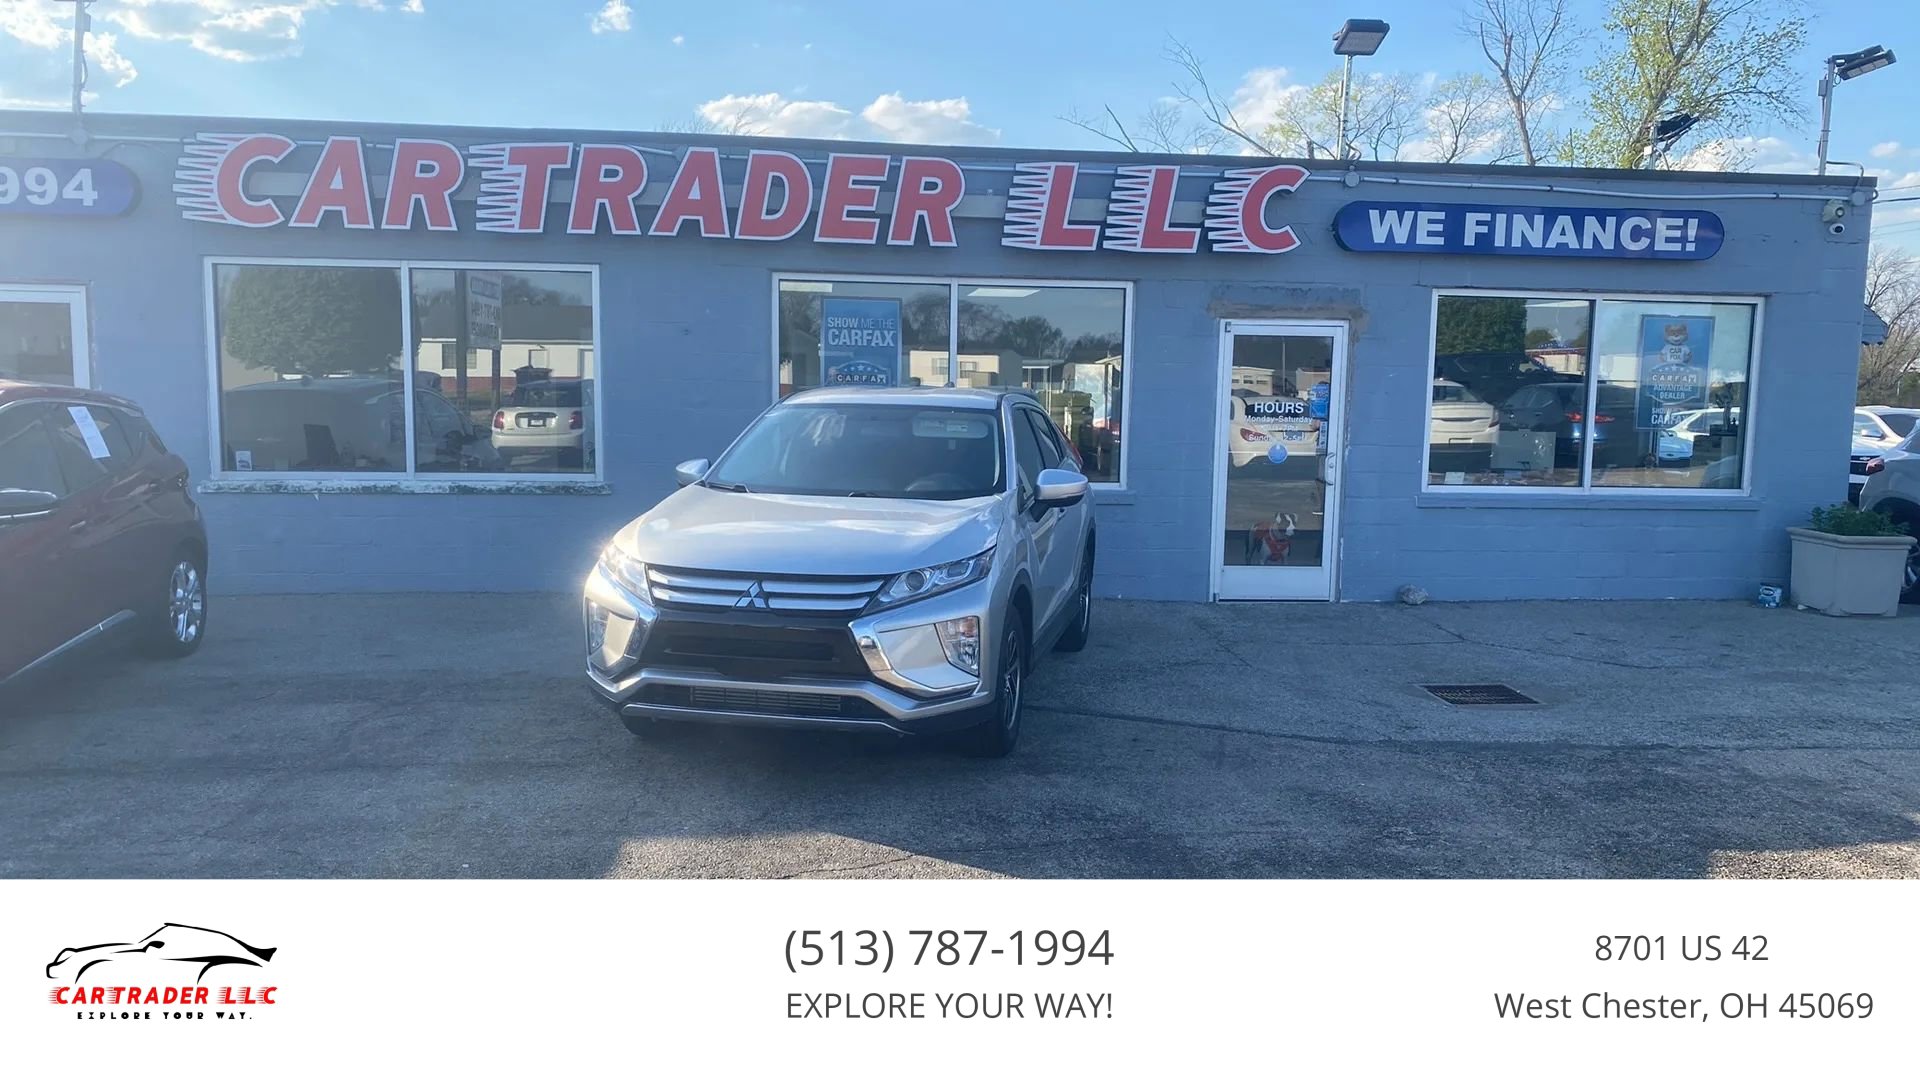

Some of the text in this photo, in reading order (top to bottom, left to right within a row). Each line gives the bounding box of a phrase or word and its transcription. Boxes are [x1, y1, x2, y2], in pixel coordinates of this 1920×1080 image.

[1001, 164, 1311, 254] LLC
[1368, 209, 1699, 252] WE FINANCE!
[827, 316, 895, 330] SHOW ME THE
[827, 328, 896, 347] CARFAX
[836, 374, 887, 384] CARFAX
[1653, 384, 1693, 392] ADVANTAGE
[1659, 391, 1686, 400] DEALER
[1254, 402, 1304, 414] HOURS
